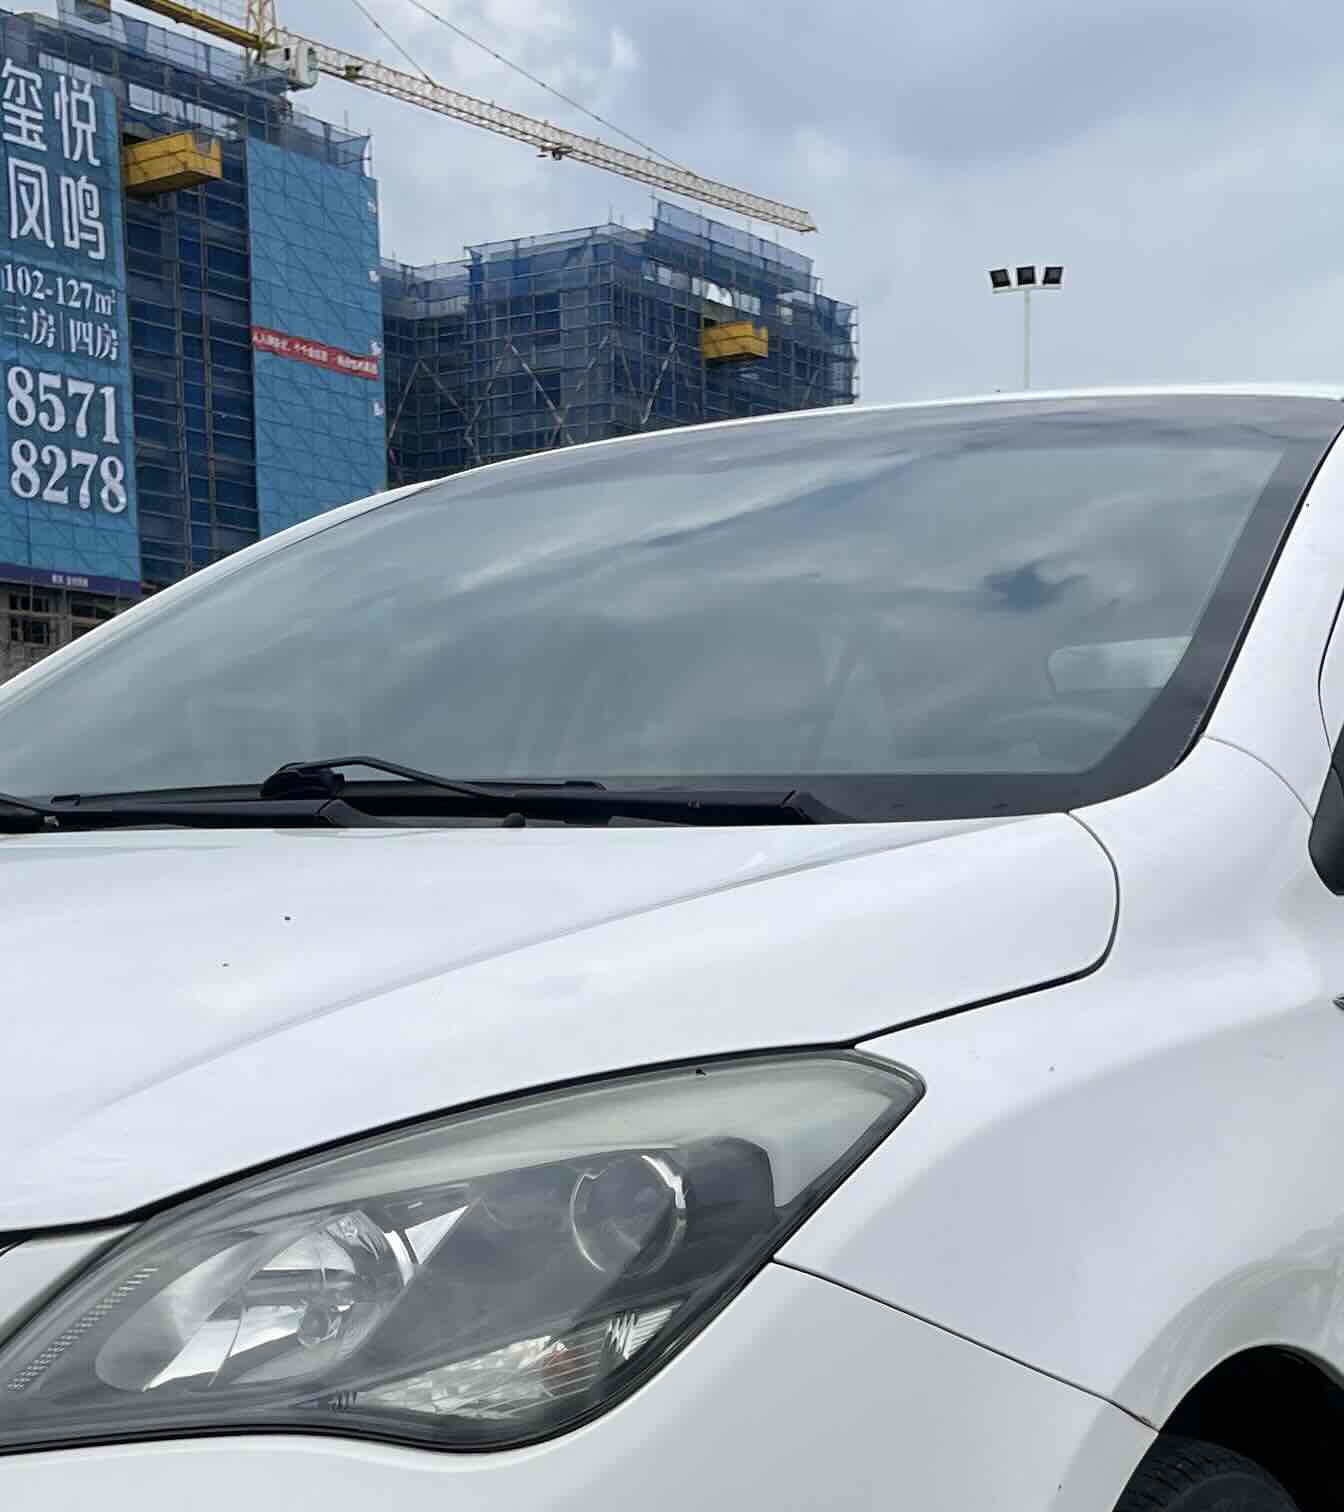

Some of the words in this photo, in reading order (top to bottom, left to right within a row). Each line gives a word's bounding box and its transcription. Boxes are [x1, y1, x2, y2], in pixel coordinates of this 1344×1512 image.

[1, 57, 101, 167] 玺悦
[8, 156, 105, 260] 凤鸣
[7, 366, 120, 444] 8571
[11, 439, 128, 513] 8278
